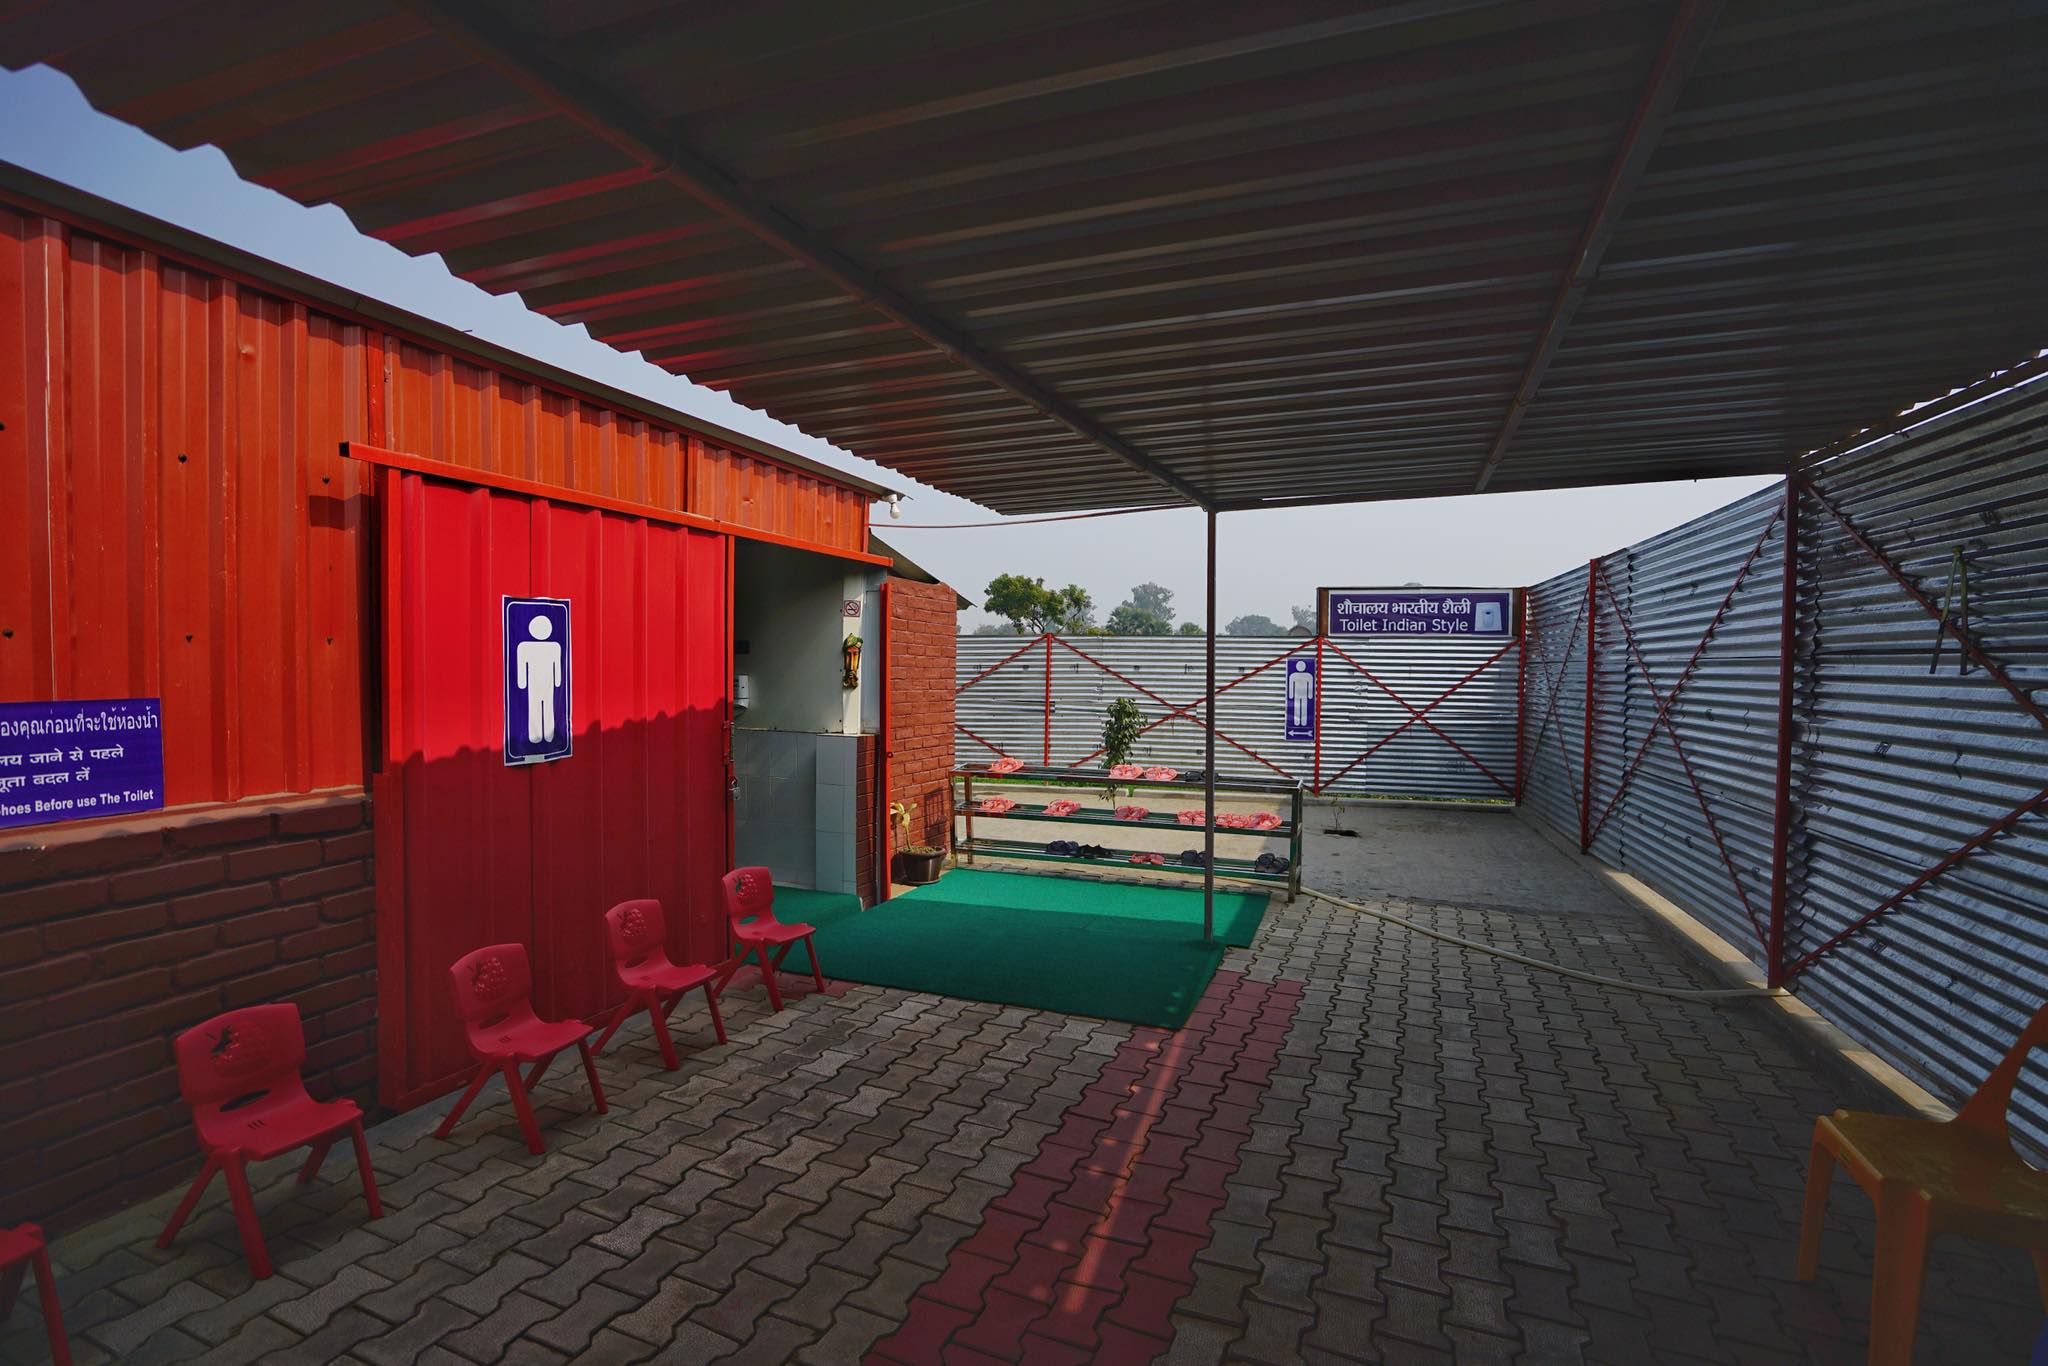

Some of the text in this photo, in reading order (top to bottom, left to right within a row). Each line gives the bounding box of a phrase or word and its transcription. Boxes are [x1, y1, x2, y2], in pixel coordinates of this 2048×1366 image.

[1337, 598, 1471, 615] शौचालय भारतीय शैली
[1339, 618, 1469, 634] Toilet Indian Style
[29, 747, 63, 764] जाने
[69, 746, 84, 761] से
[90, 743, 125, 760] पहले
[32, 771, 69, 785] बदल
[75, 766, 91, 782] लें
[0, 788, 154, 817] hoes Before use The Toilet
